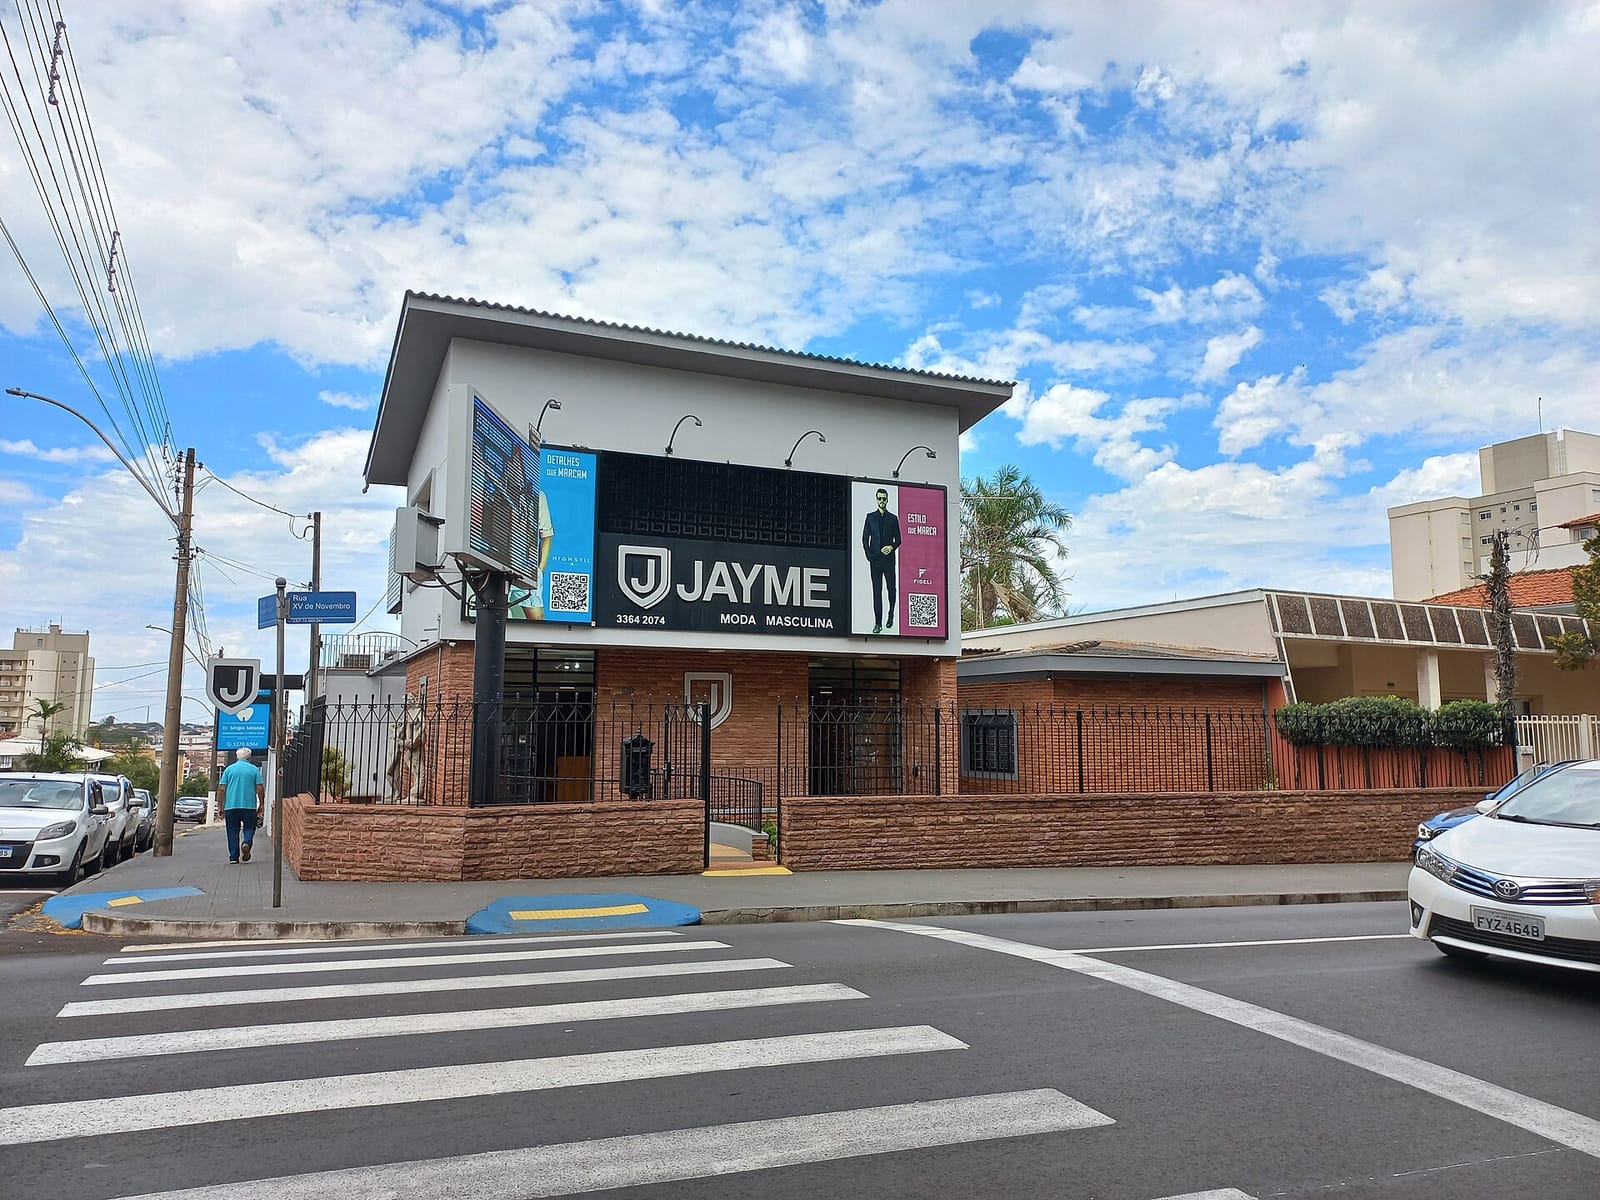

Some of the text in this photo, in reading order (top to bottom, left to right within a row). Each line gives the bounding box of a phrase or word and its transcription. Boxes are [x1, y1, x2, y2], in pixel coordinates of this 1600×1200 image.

[546, 454, 580, 467] DETALHES
[546, 467, 588, 479] QUE MARCAM
[907, 513, 927, 524] ESTILO
[907, 525, 937, 536] QUE MARCA
[676, 560, 831, 608] JAYME
[292, 594, 307, 602] Rua
[616, 614, 666, 625] 3364 2074
[720, 613, 834, 629] MODA MASCULINA
[220, 669, 247, 703] J
